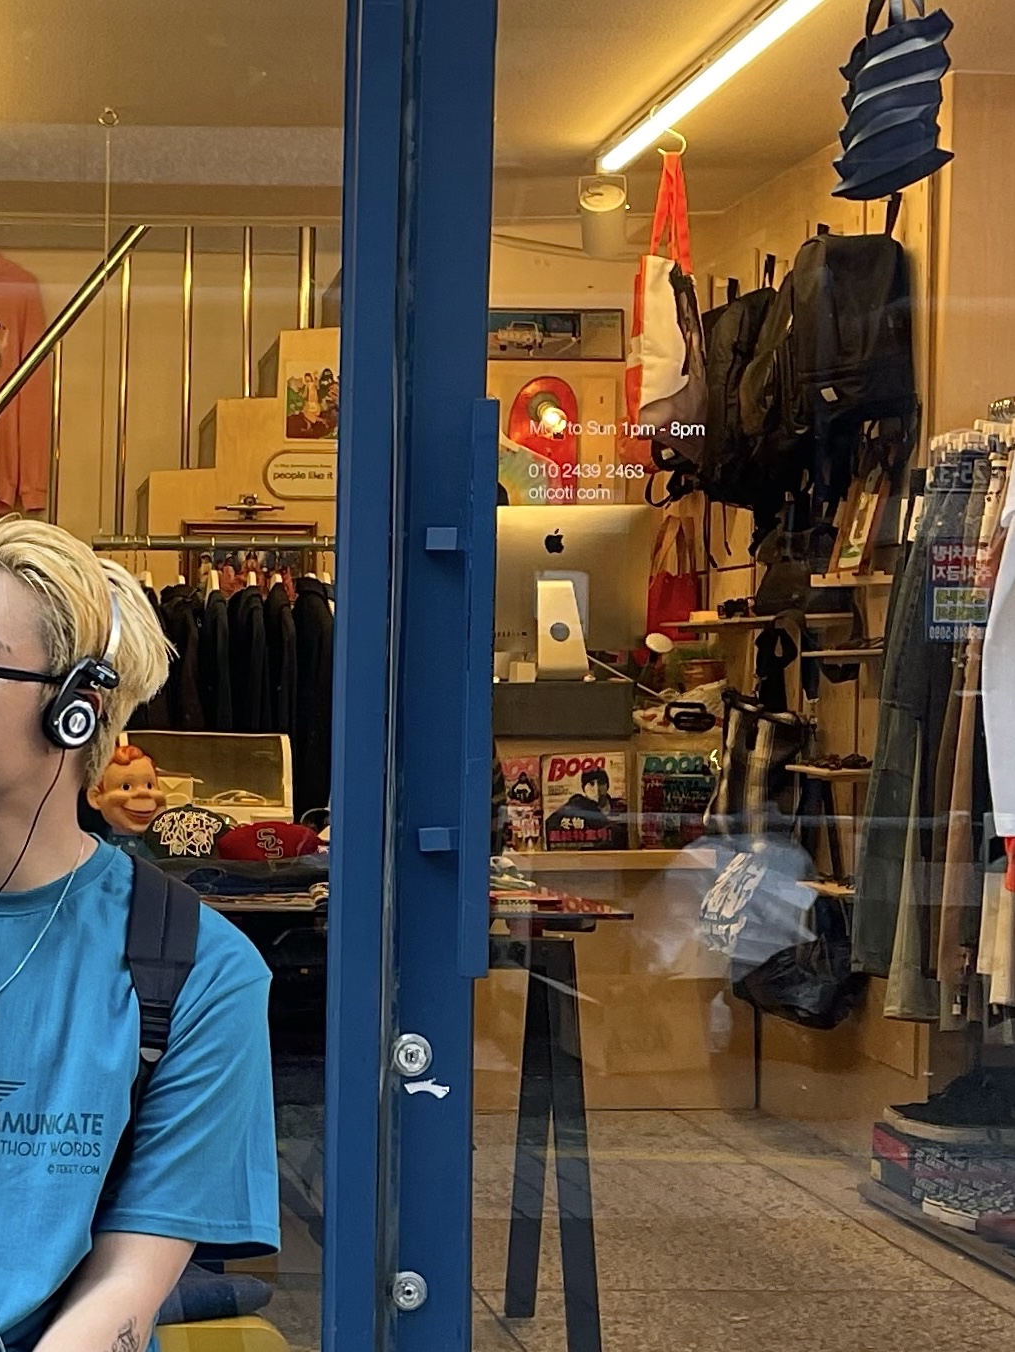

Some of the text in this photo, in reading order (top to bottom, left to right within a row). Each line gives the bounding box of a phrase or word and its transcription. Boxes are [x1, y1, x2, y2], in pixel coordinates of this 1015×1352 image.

[567, 421, 583, 435] to
[587, 420, 617, 435] Sun
[622, 421, 656, 439] 1pm
[670, 421, 706, 439] 8pm
[528, 463, 645, 479] 010 2439 2463
[50, 1140, 102, 1158] WORDS
